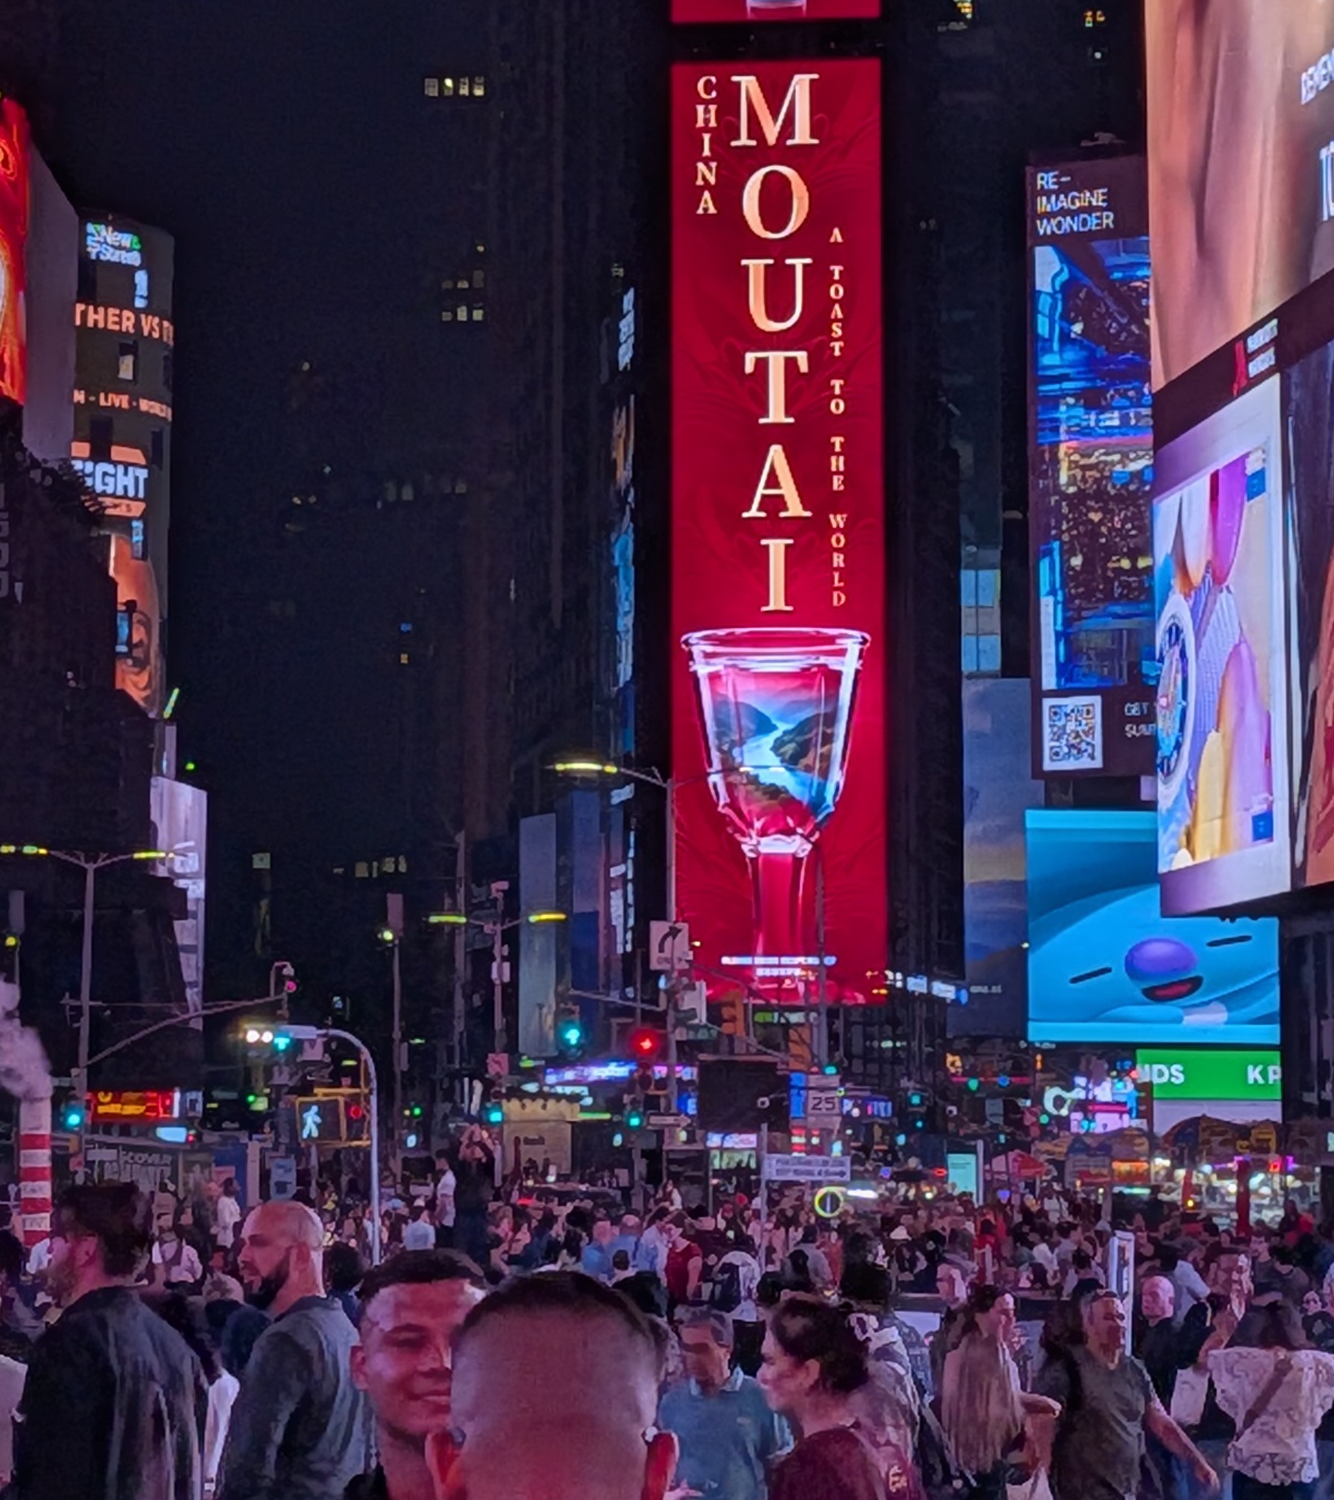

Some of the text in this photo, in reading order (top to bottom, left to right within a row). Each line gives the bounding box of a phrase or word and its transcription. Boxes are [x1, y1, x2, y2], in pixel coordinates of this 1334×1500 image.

[696, 76, 717, 214] CHINA
[1037, 171, 1071, 190] RE-
[1037, 187, 1108, 214] IMAGINE
[1037, 211, 1114, 236] WONDER
[140, 313, 160, 339] VS
[730, 74, 819, 612] MOUTAI
[829, 227, 847, 607] A TOAST TO THE WORLD
[811, 1096, 836, 1111] 25
